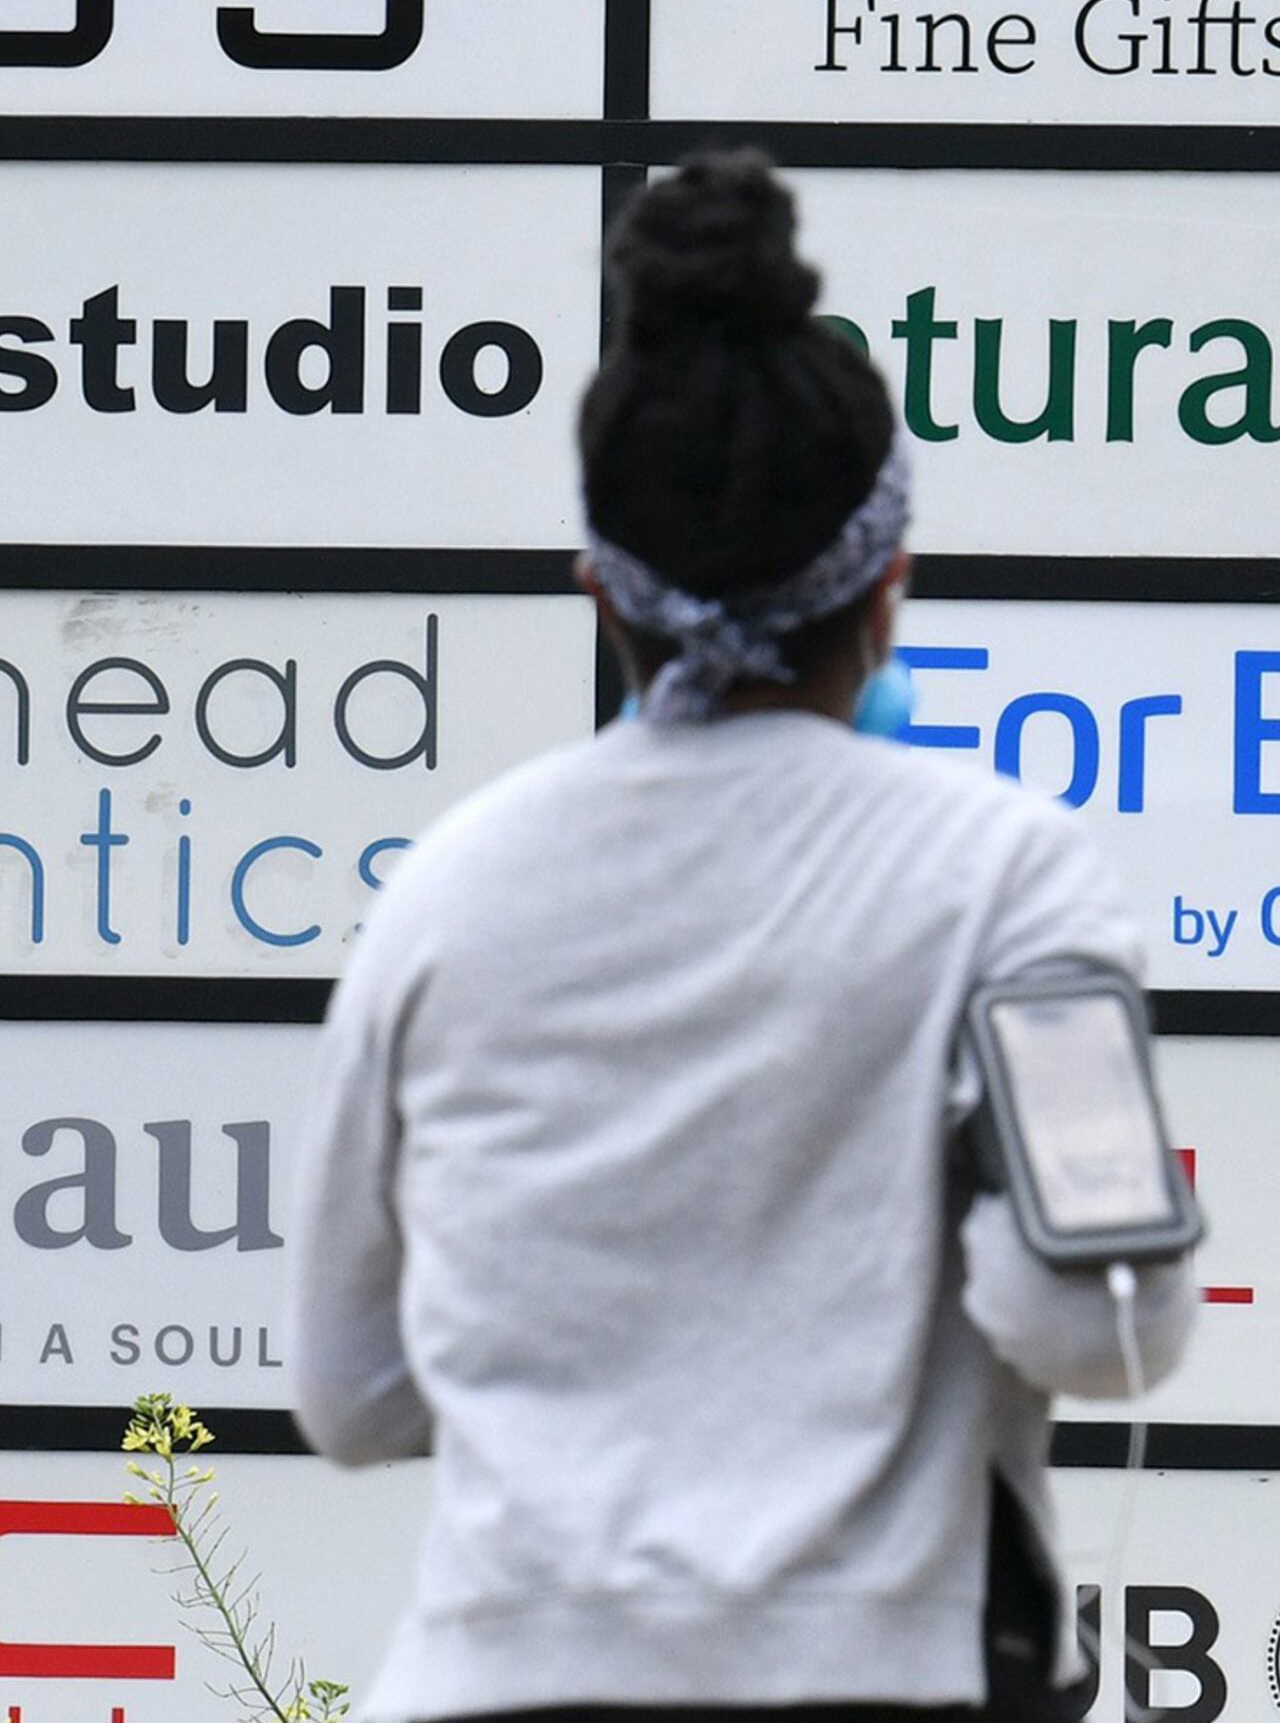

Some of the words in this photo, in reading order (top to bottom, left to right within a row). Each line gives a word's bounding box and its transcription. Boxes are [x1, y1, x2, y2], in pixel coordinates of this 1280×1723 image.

[1174, 896, 1237, 957] by
[41, 1325, 72, 1363] A
[111, 1325, 282, 1366] SOUL
